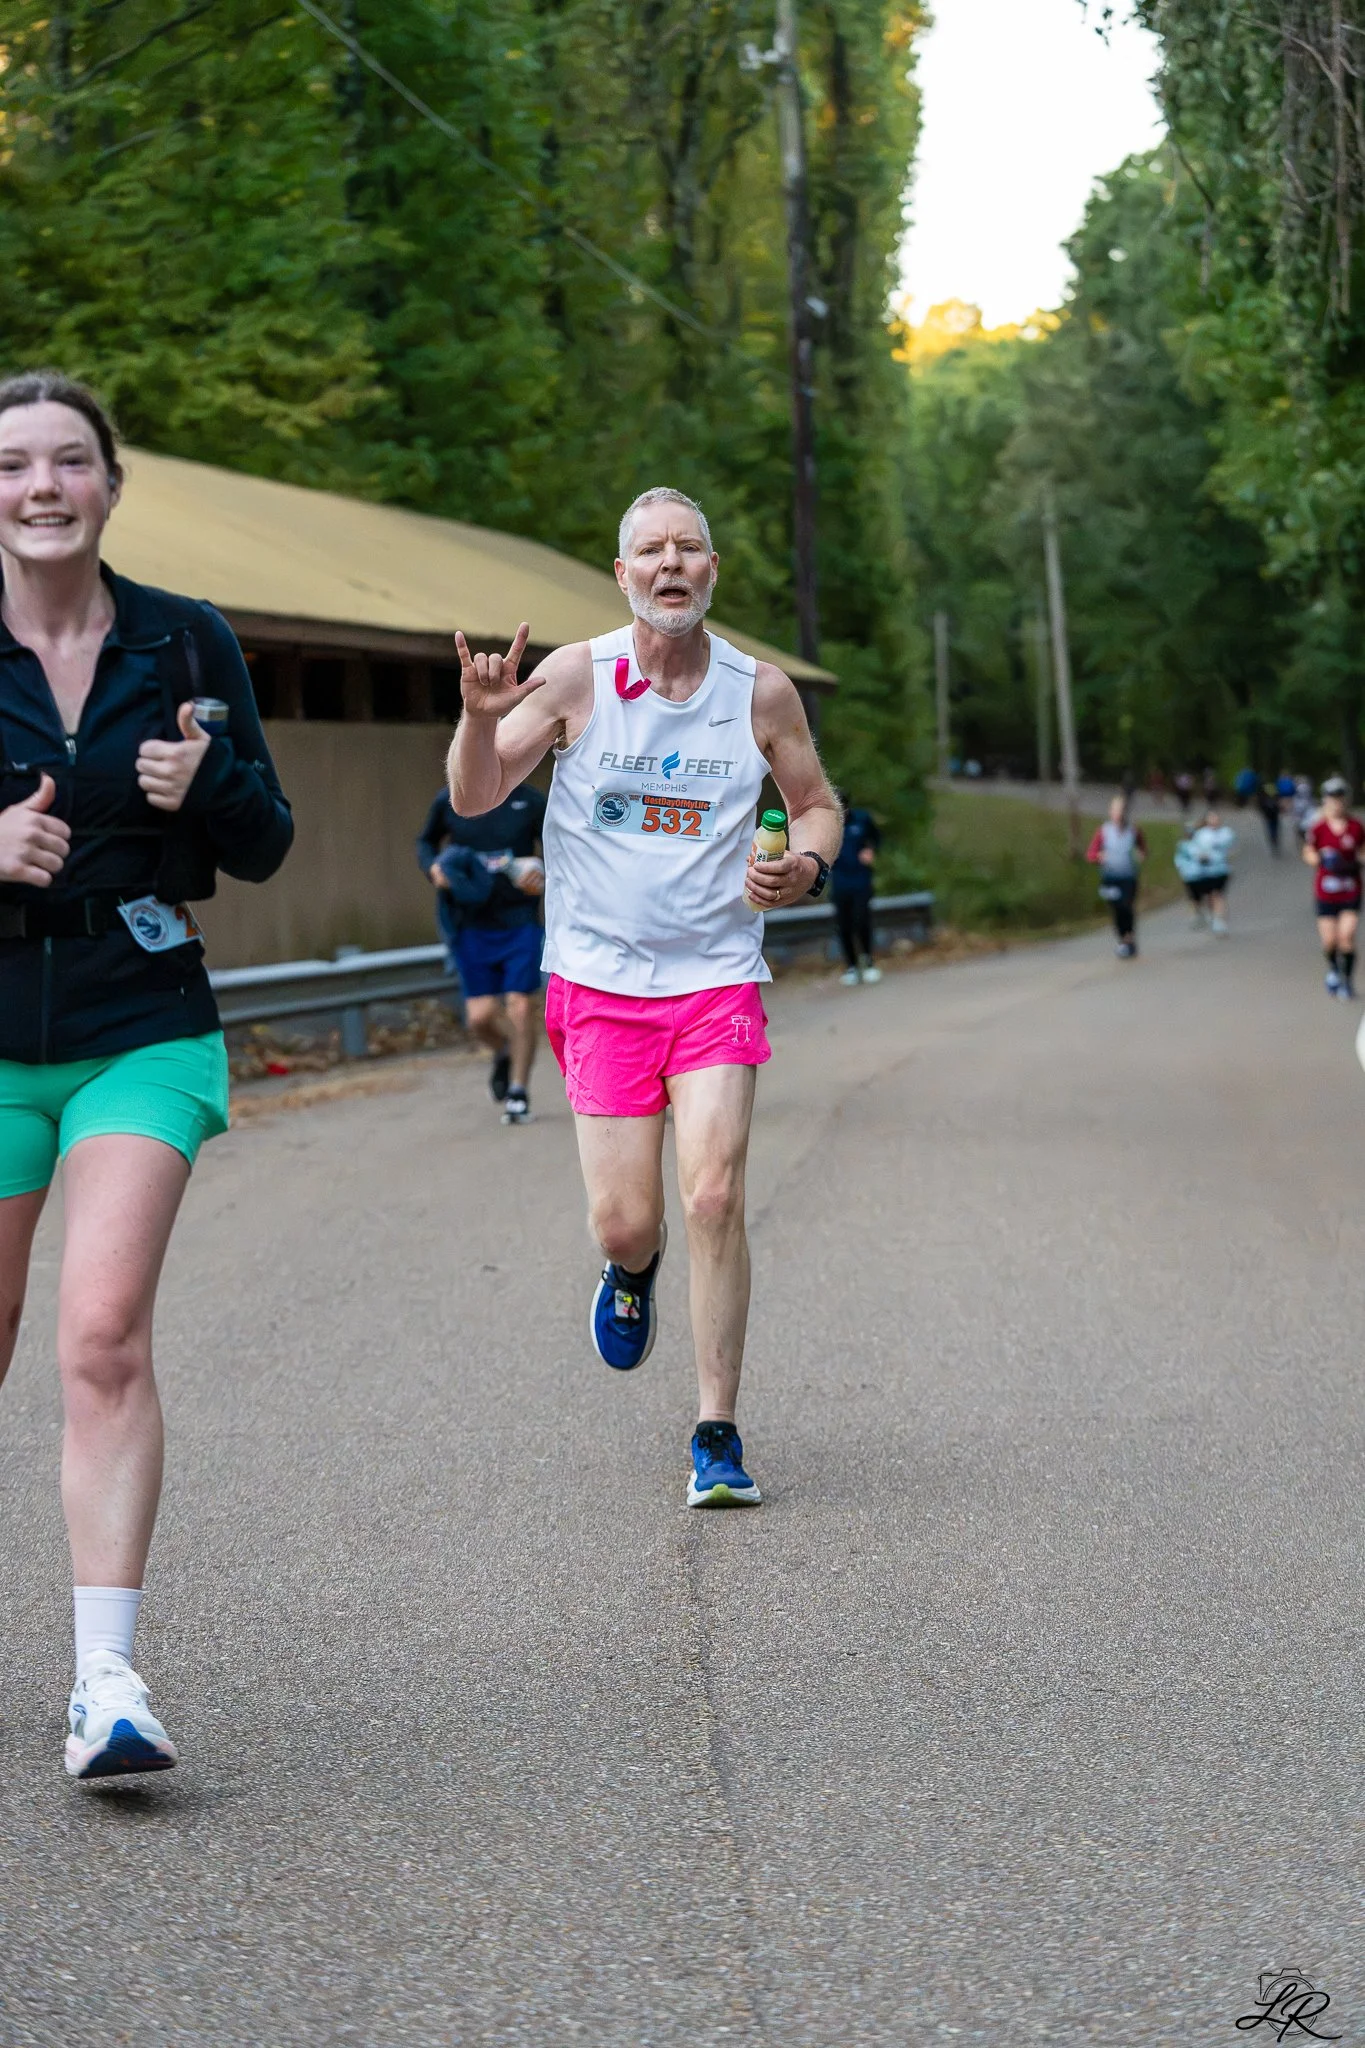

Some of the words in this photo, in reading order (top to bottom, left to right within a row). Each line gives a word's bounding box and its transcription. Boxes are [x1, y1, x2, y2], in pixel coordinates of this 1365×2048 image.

[599, 751, 658, 772] FLEET
[684, 758, 734, 776] FEET
[641, 782, 688, 793] MEMPHIS
[641, 806, 702, 836] 532
